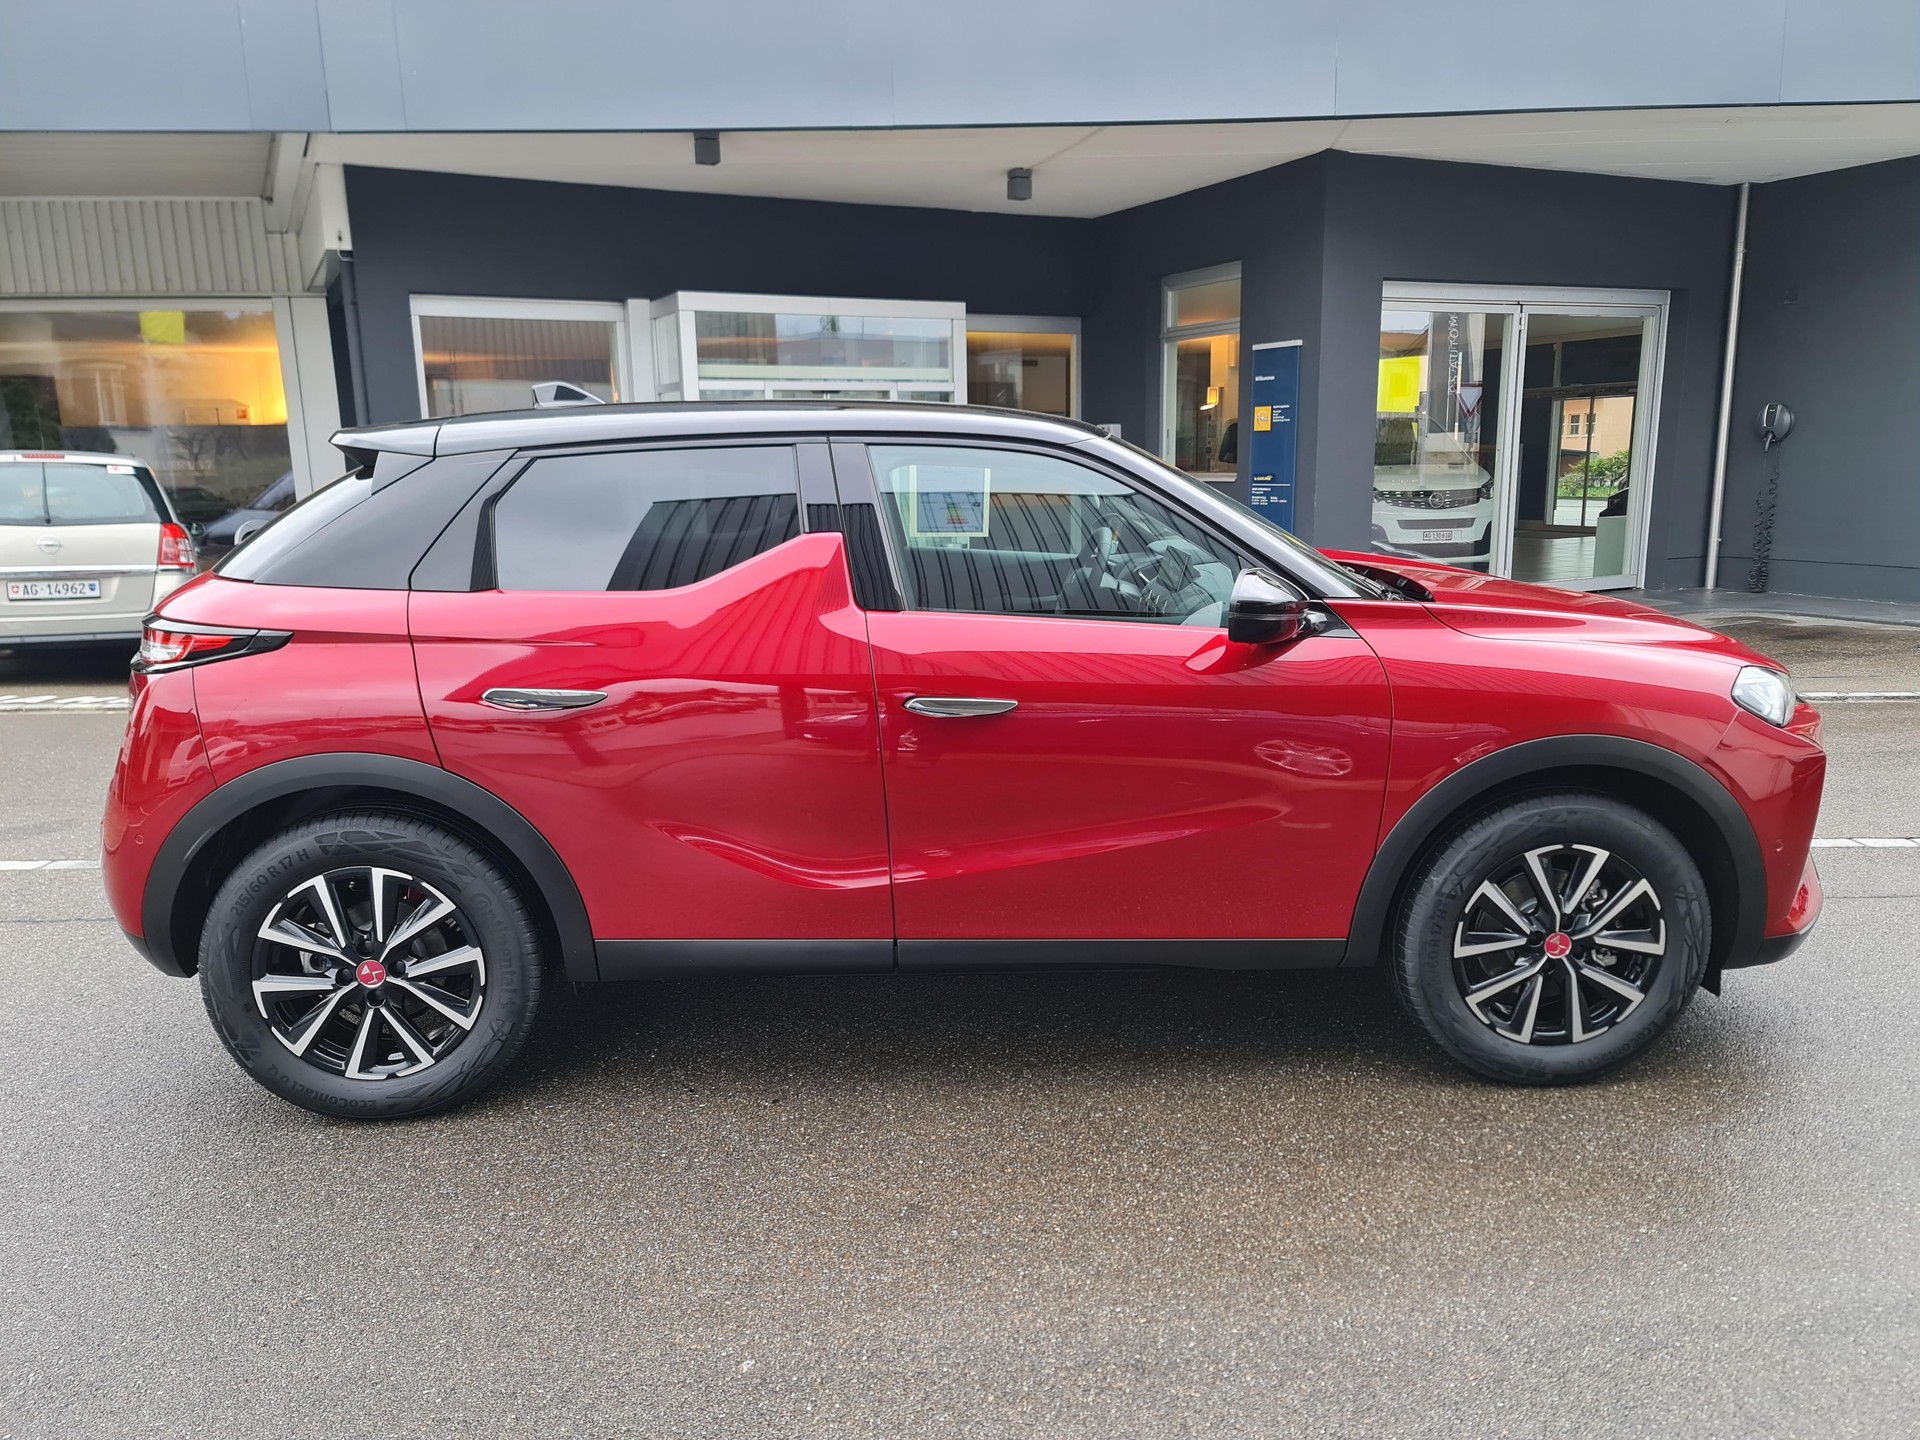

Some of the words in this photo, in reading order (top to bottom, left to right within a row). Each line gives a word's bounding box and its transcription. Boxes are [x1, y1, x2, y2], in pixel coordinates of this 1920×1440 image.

[22, 583, 38, 596] AG
[47, 583, 86, 595] 14962
[230, 873, 270, 915] 215/60
[296, 848, 310, 861] H
[292, 1080, 377, 1110] EcoContact
